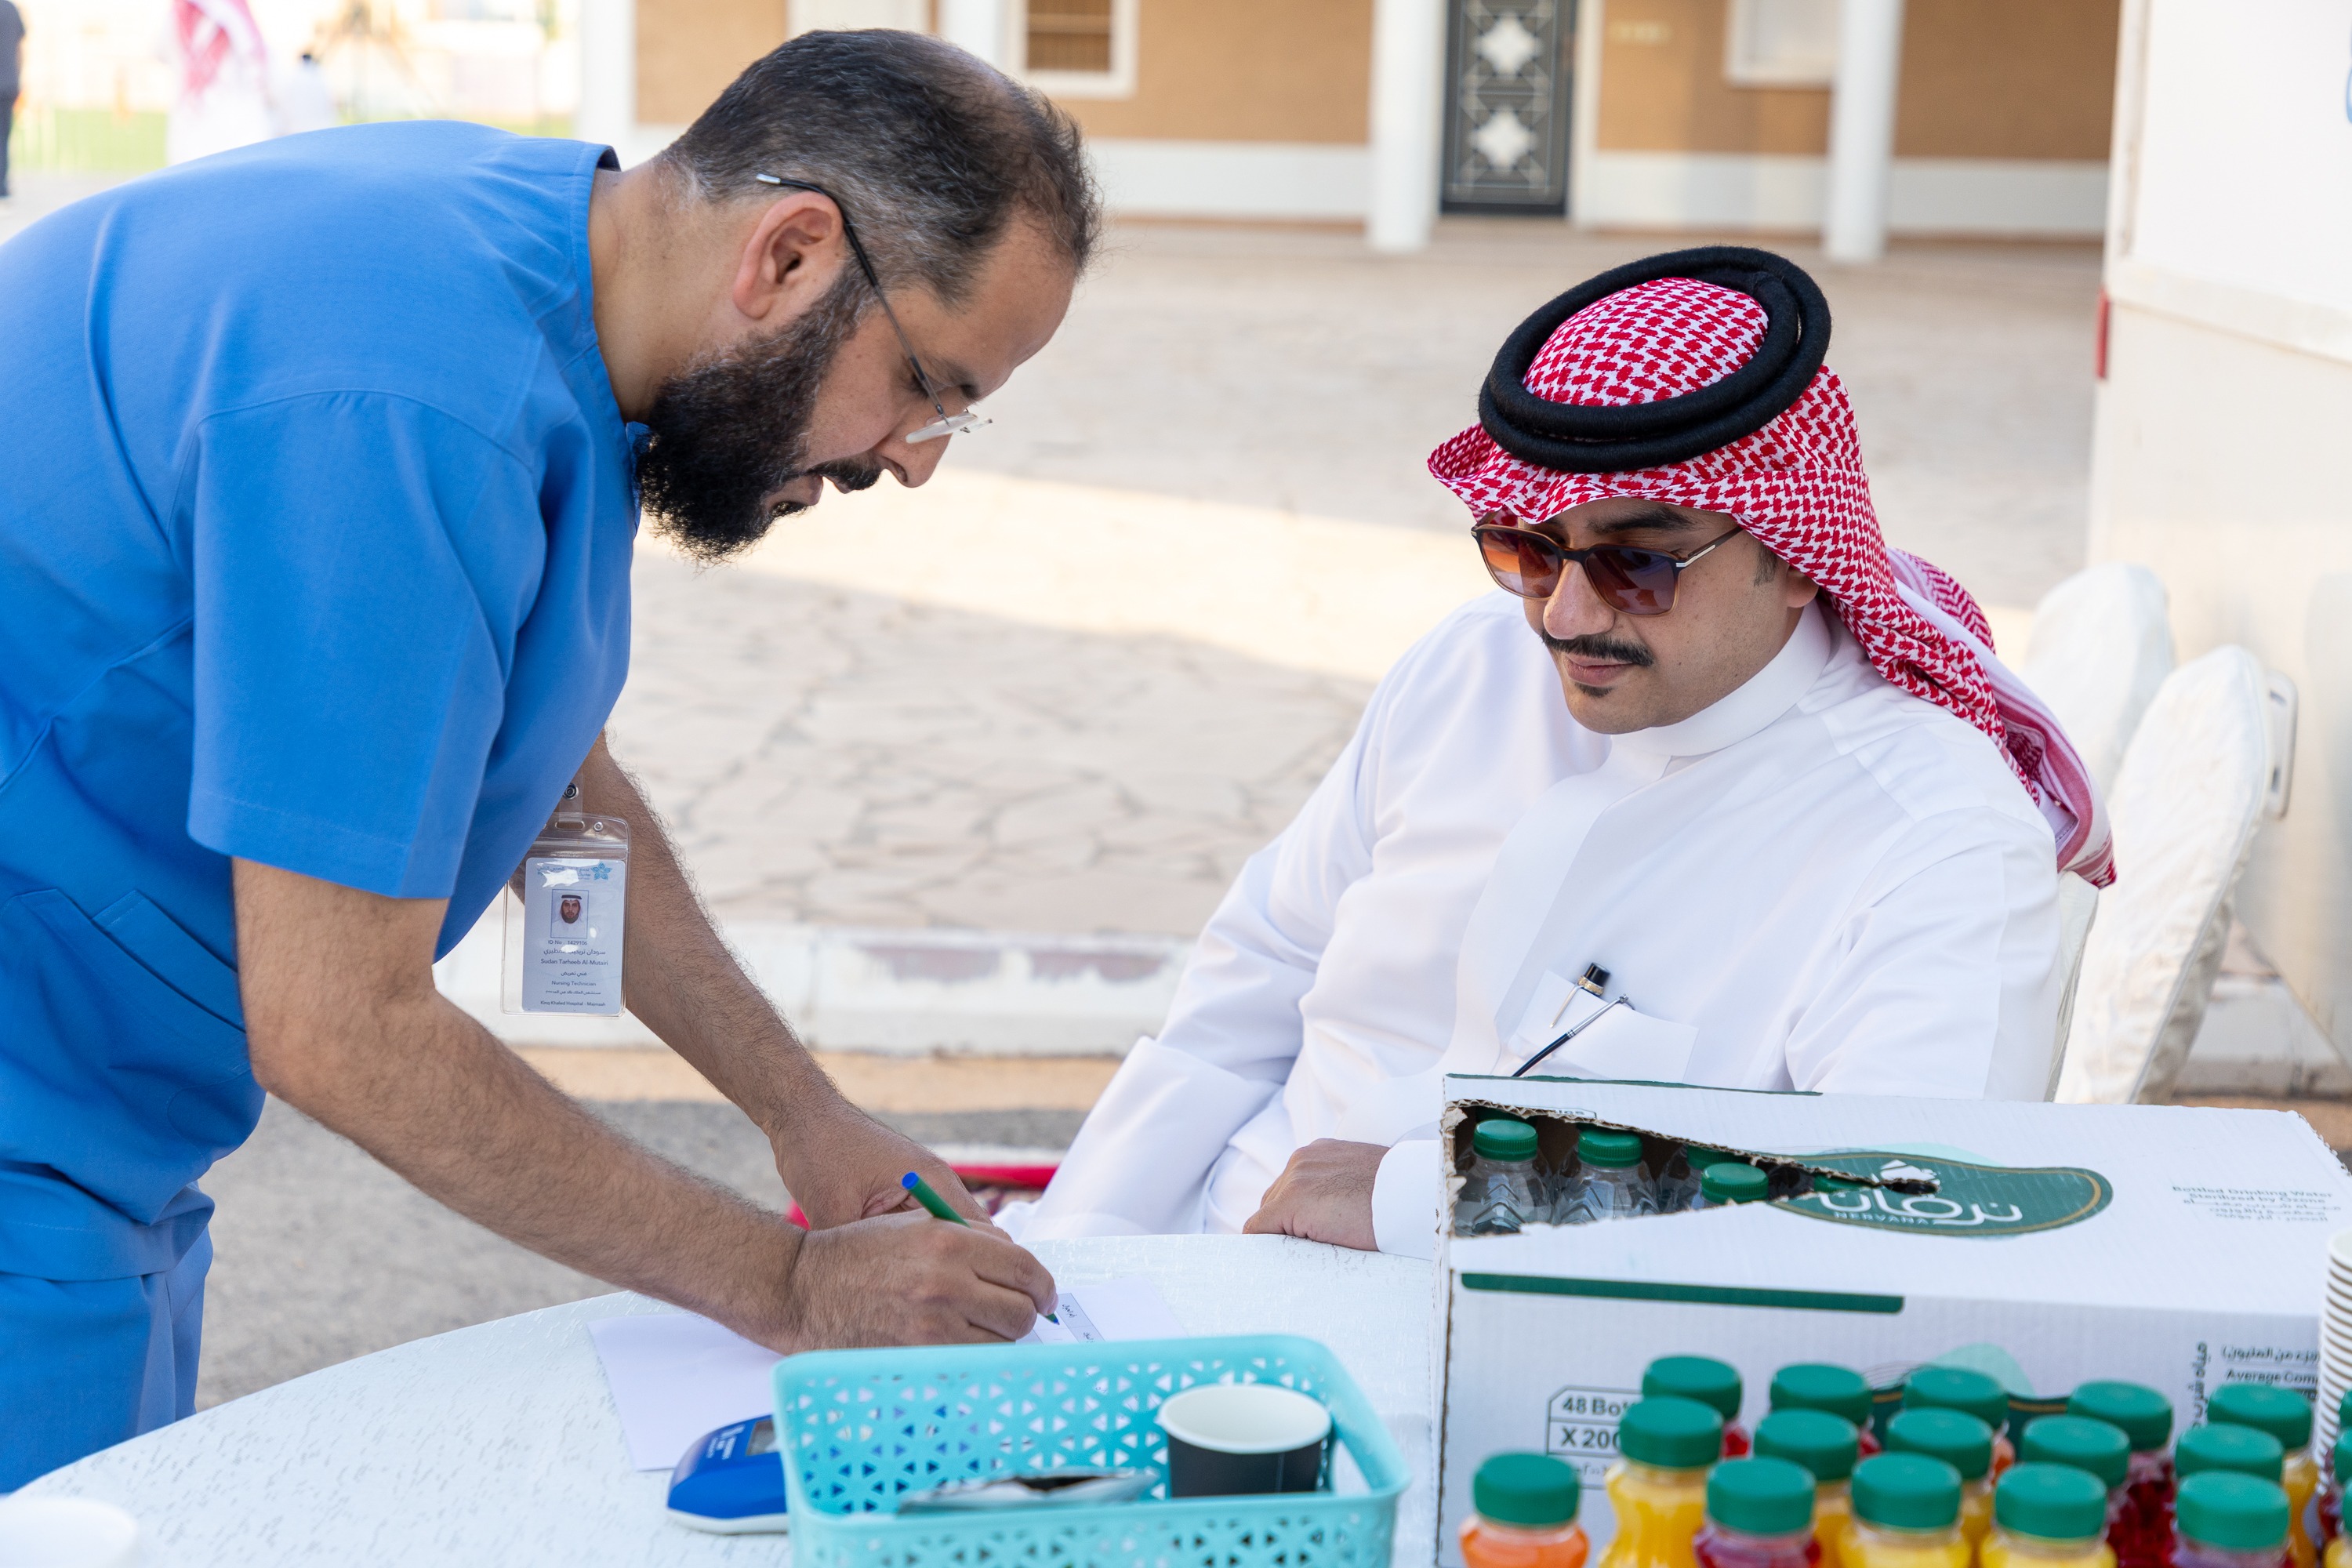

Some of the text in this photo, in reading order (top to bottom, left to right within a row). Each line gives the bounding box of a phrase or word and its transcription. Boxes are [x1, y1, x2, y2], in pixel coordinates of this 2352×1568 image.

[2172, 1185, 2224, 1194] Bottled
[2228, 1189, 2288, 1197] Drinking
[2190, 1193, 2255, 1202] Sterilized
[1835, 1211, 1929, 1225] NERVANA
[2227, 1369, 2281, 1385] Average
[1563, 1396, 1588, 1414] 48
[1561, 1425, 1577, 1446] X
